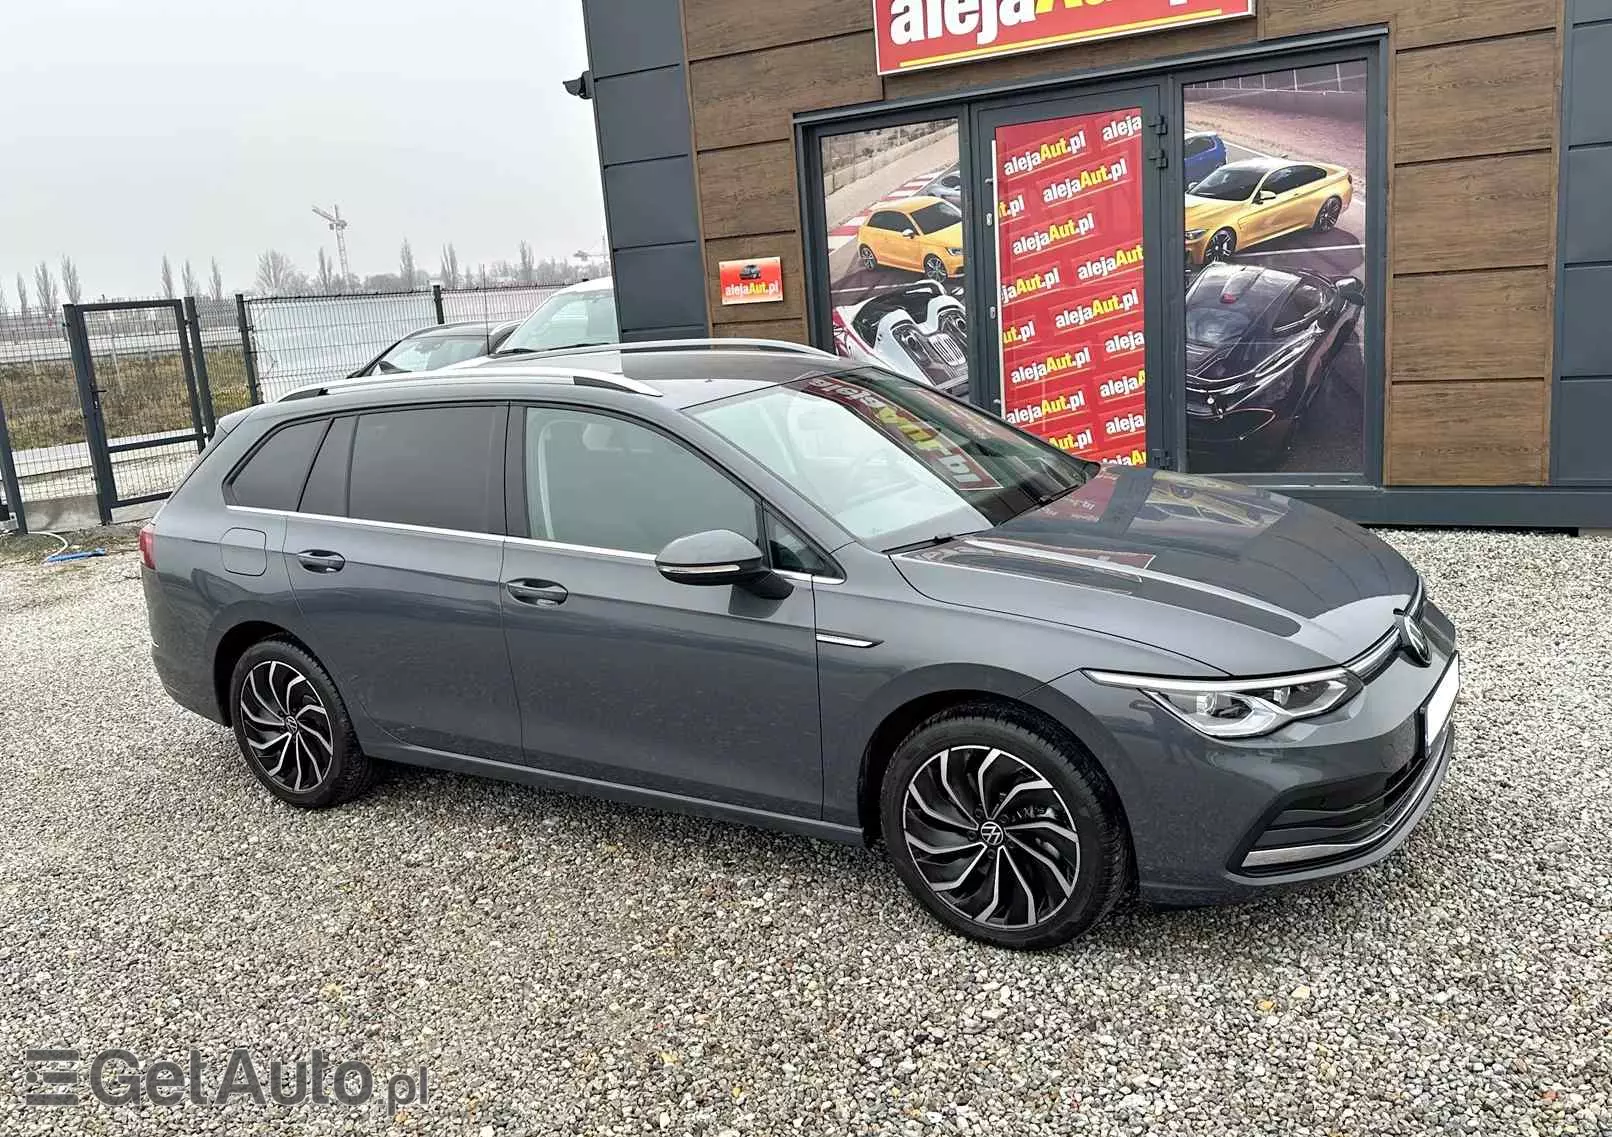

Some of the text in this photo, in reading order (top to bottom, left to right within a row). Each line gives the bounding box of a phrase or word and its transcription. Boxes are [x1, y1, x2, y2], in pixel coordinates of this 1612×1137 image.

[1102, 115, 1141, 141] aleja
[1004, 131, 1086, 176] alejaAut.pl
[1043, 158, 1127, 202] alejaAut.pl
[999, 194, 1024, 217] t.pl
[1012, 213, 1094, 255] alejaAut.pl
[725, 280, 778, 297] alejaAut.pl
[1055, 289, 1139, 328] alejaAut.pl
[1105, 331, 1144, 353] aleja
[1011, 347, 1091, 384] alejaAut.pl
[1007, 390, 1085, 425] alejaAut.pl
[1106, 413, 1144, 435] aleja
